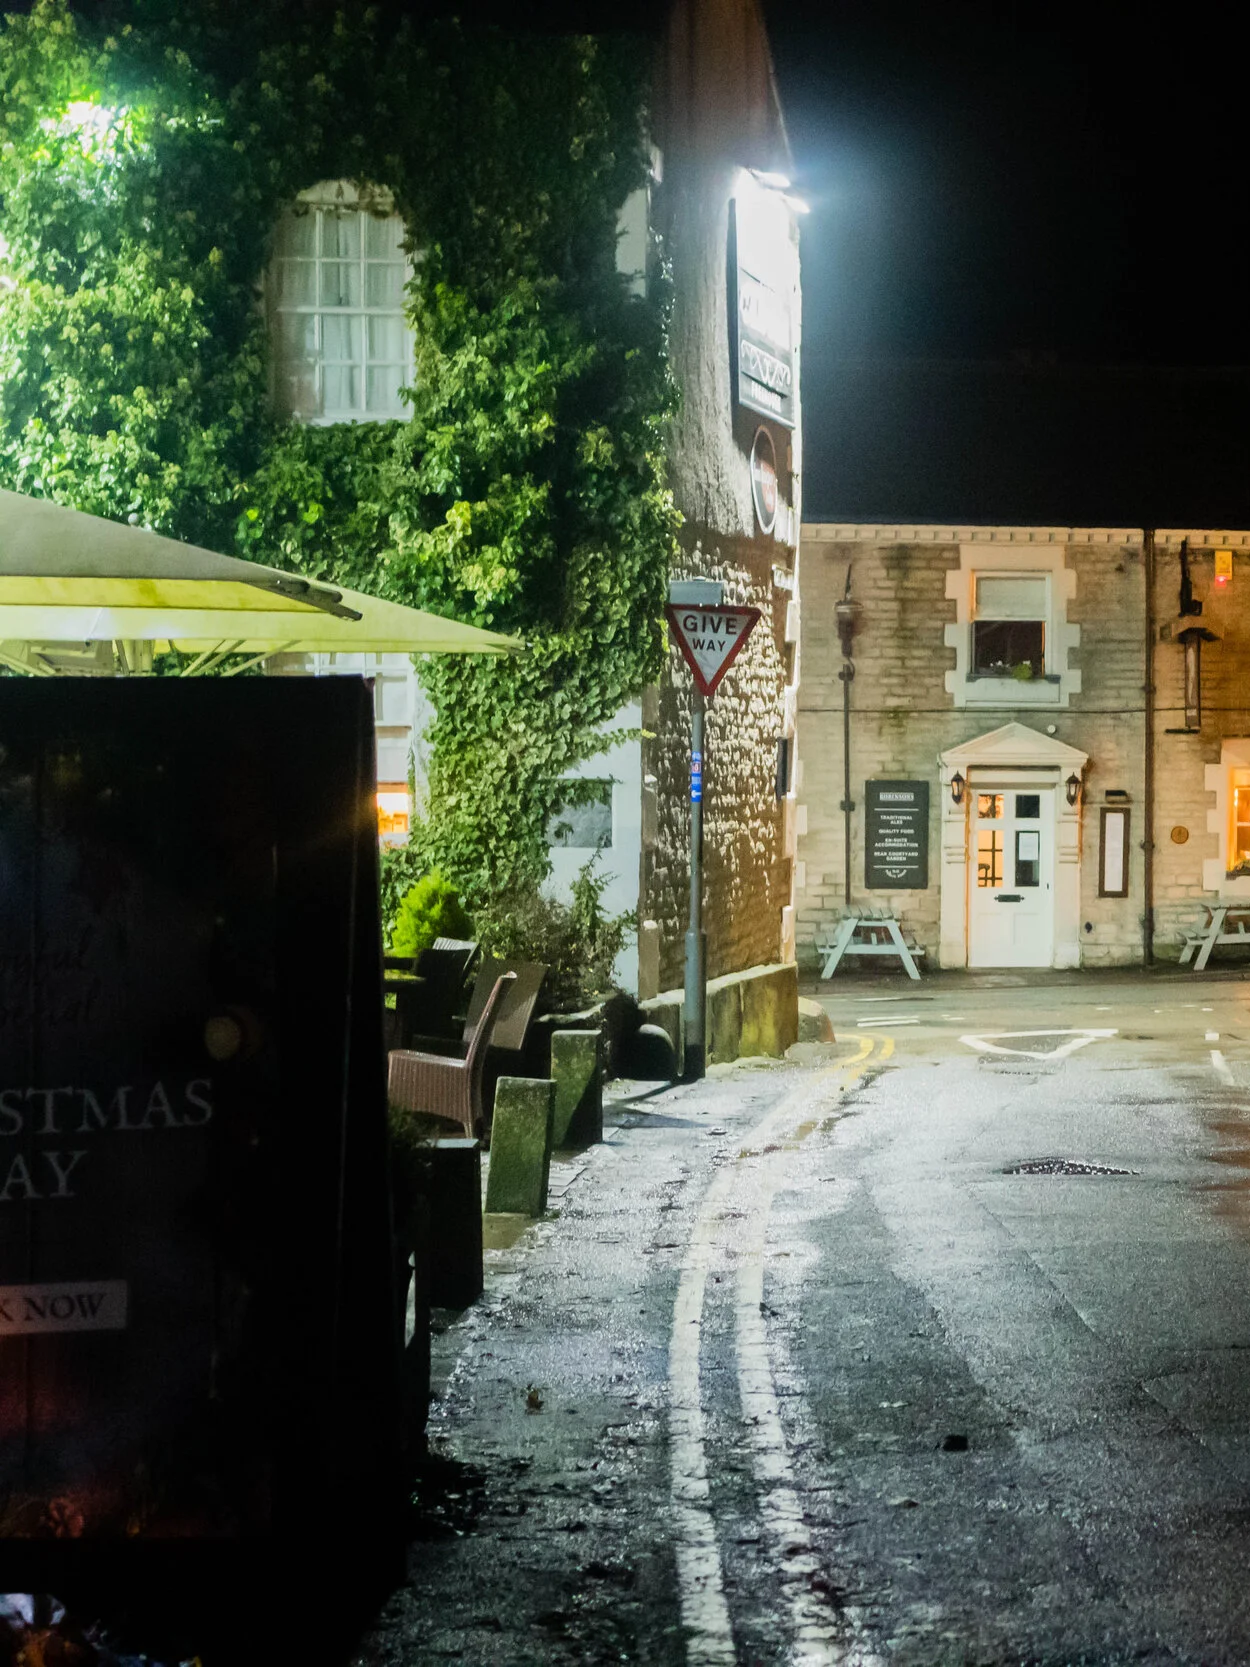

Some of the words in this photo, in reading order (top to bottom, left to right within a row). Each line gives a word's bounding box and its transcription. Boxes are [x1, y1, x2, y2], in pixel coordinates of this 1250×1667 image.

[683, 615, 737, 635] GIVE
[692, 638, 726, 652] WAY
[0, 1150, 88, 1200] AY
[23, 1293, 107, 1321] NOW
